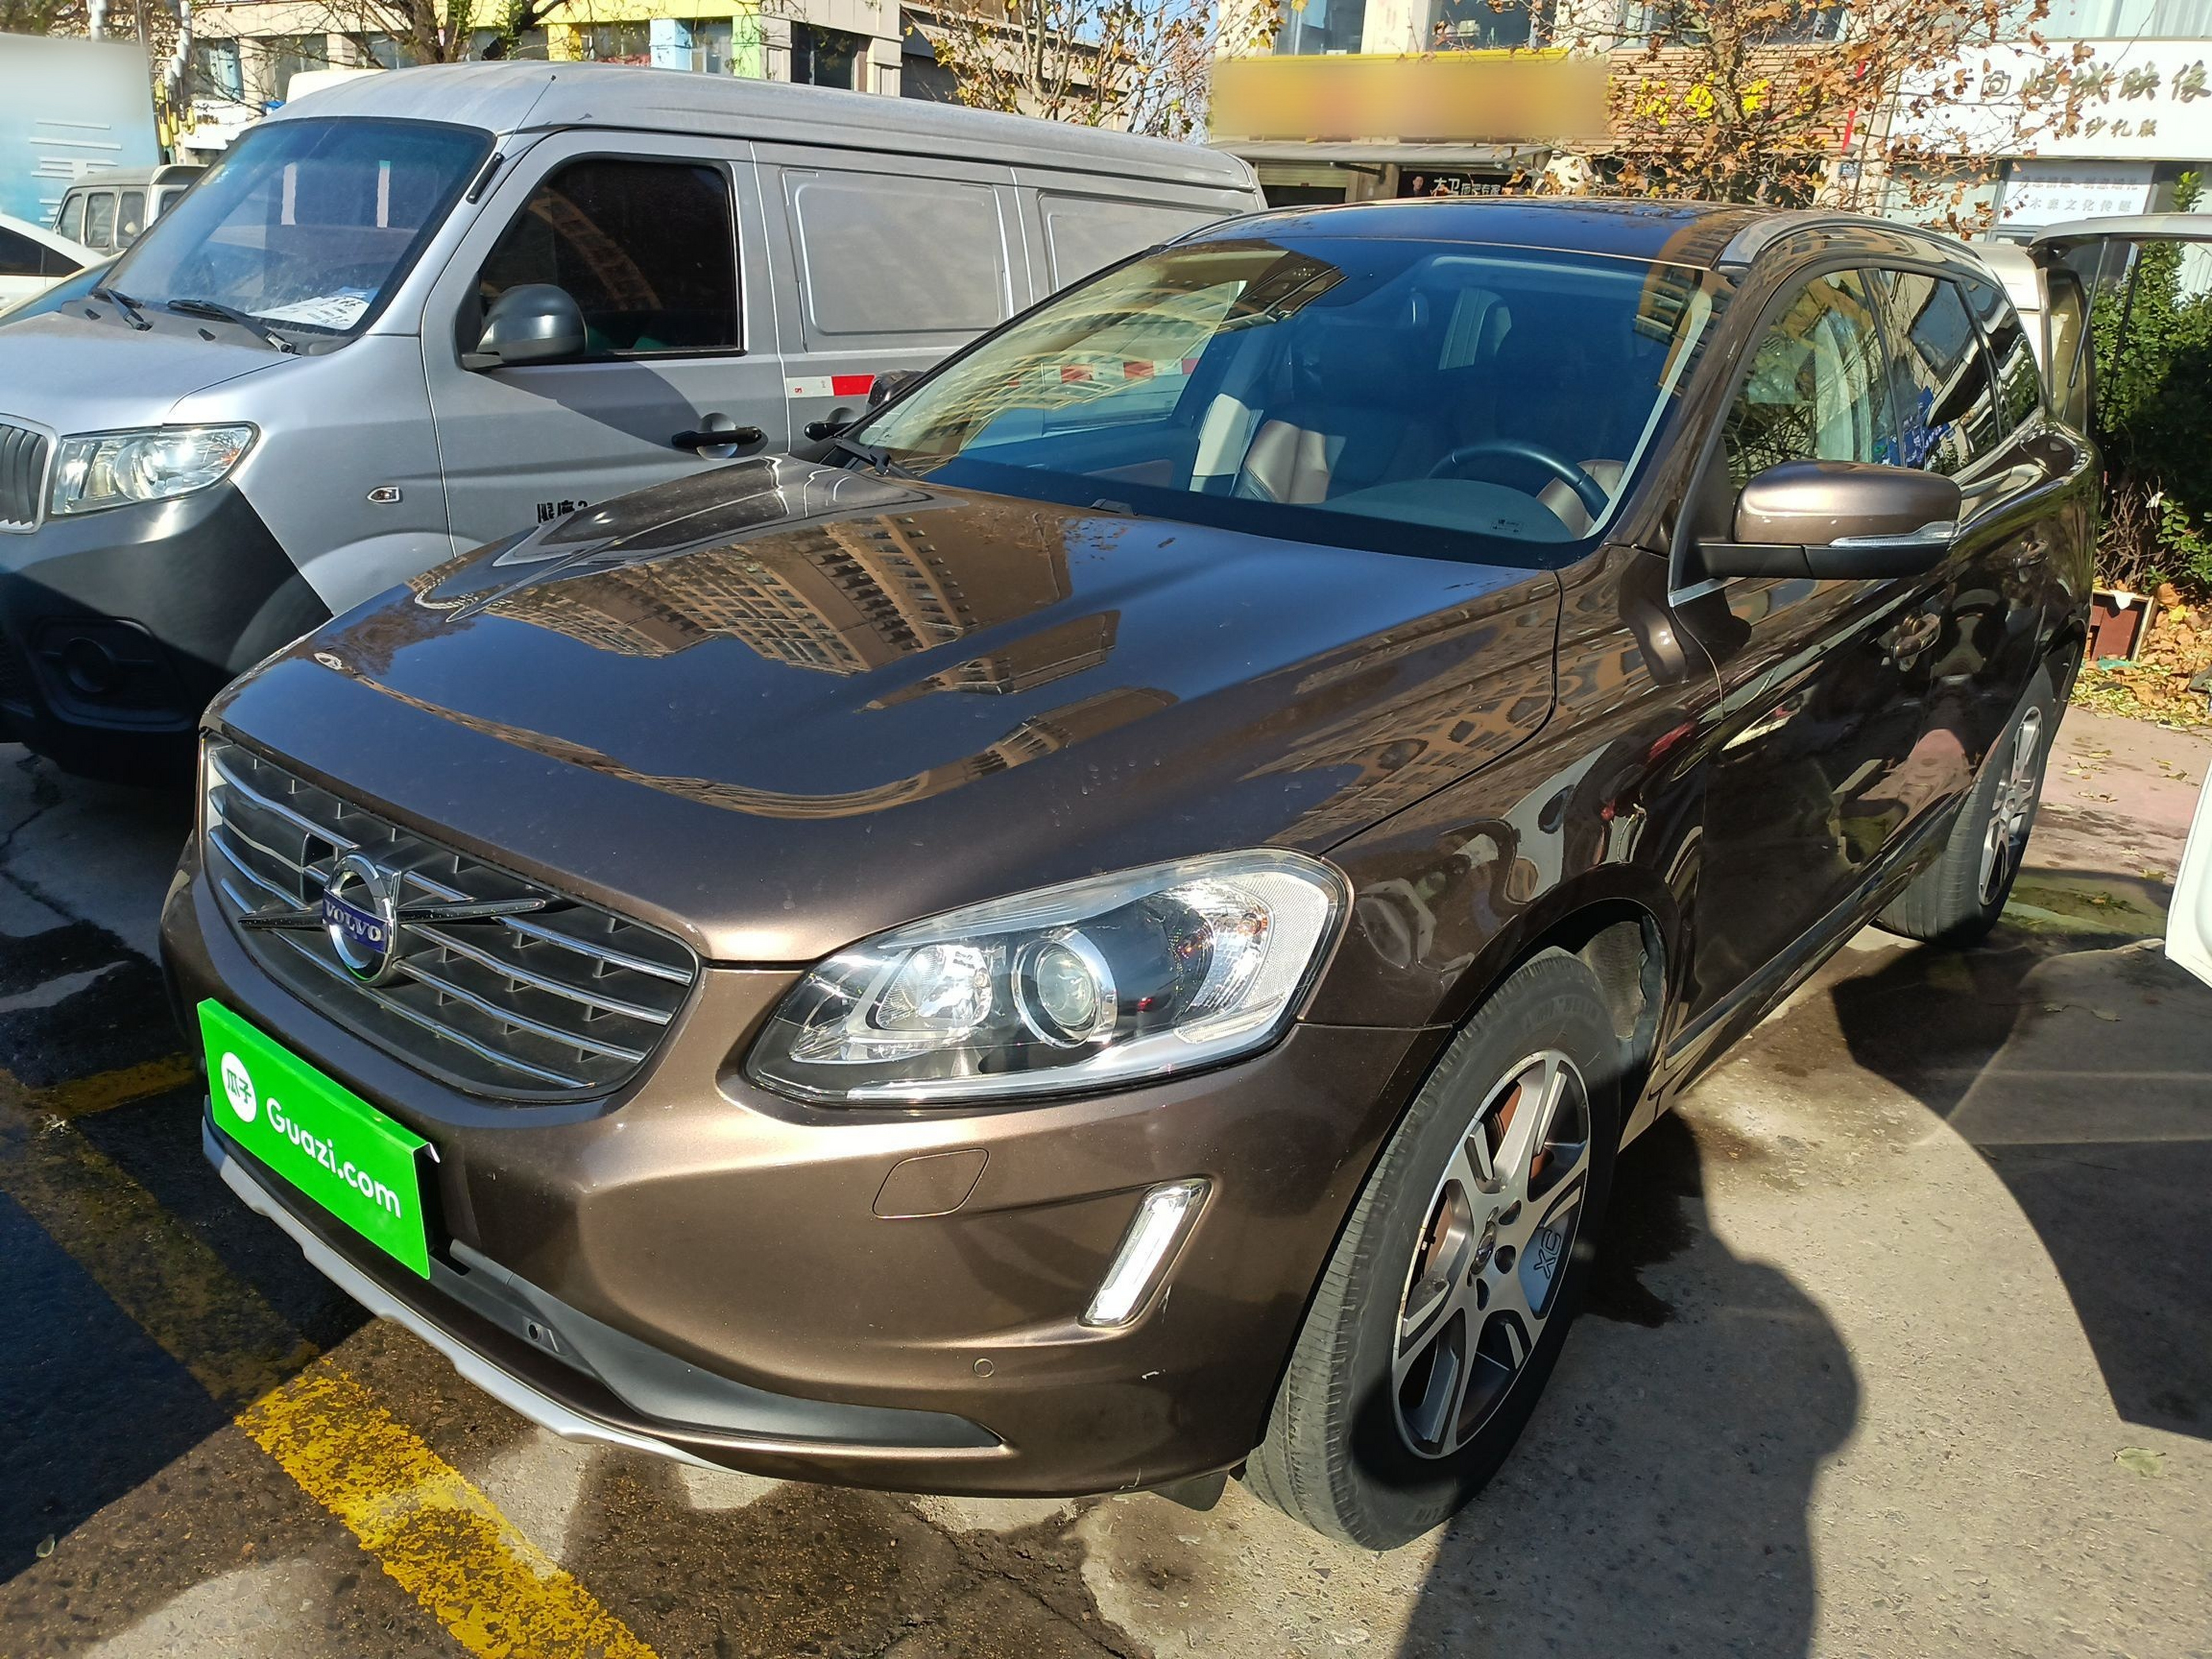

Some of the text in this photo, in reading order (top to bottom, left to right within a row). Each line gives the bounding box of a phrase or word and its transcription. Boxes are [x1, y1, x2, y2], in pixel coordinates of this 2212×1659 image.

[324, 899, 381, 941] VOLVO
[226, 1068, 402, 1219] 瓜子 Guazi.com
